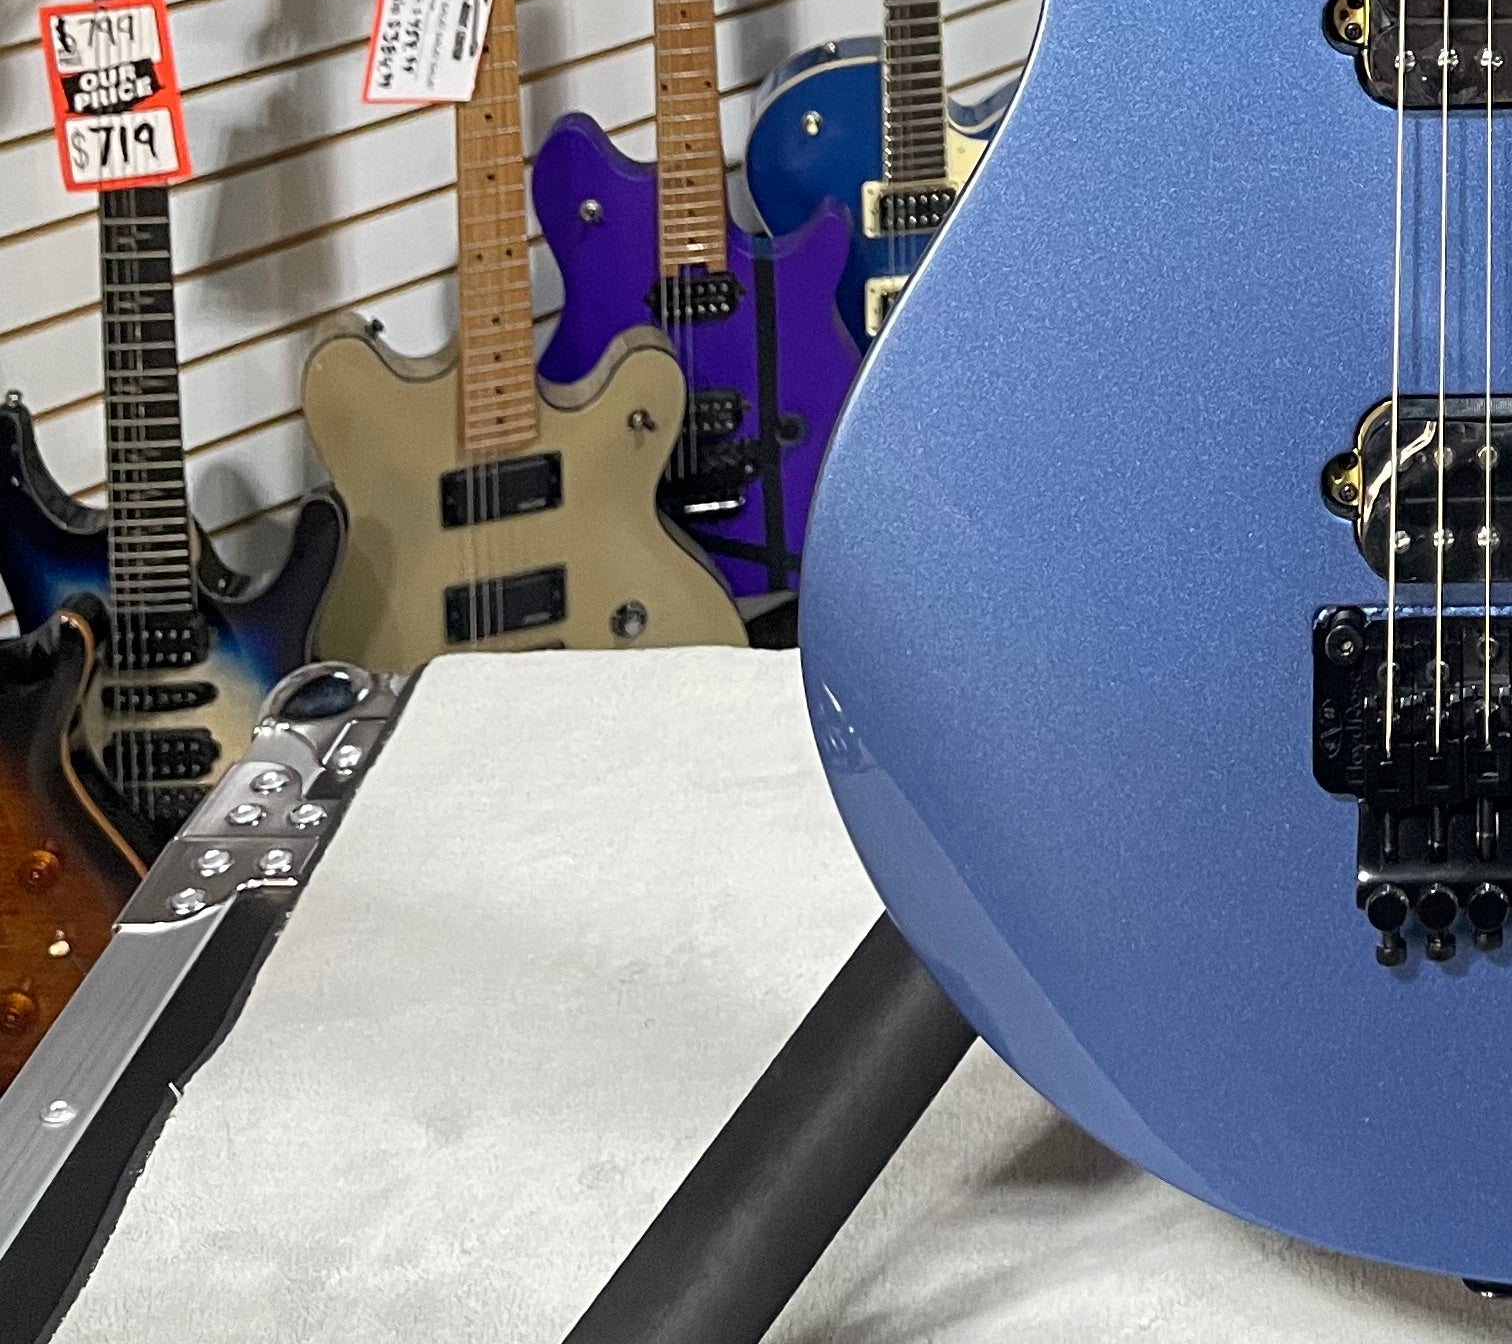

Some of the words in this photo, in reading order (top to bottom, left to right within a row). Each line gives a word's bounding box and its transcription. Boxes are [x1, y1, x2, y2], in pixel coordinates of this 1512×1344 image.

[73, 77, 154, 113] PRICE
[78, 64, 136, 92] OUR
[71, 122, 160, 171] $719
